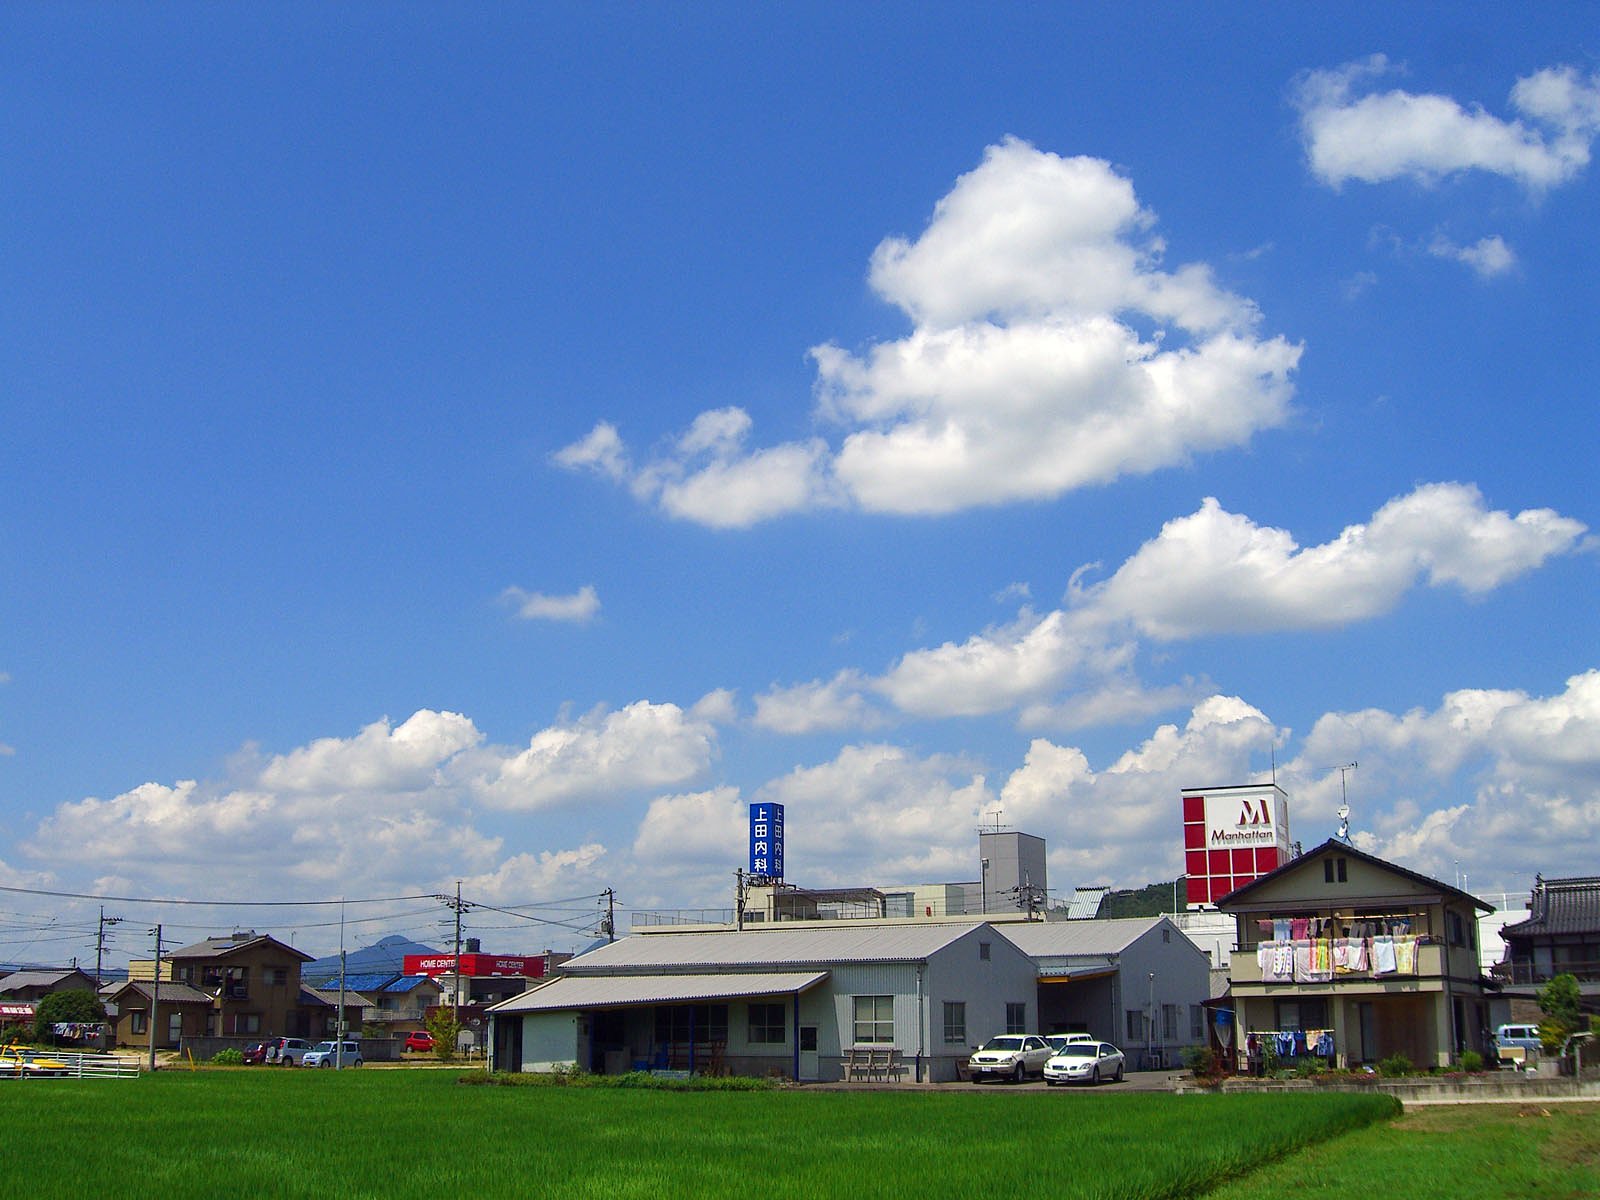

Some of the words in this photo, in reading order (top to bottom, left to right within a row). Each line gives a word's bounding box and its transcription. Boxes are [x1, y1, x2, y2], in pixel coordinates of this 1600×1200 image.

[1239, 799, 1271, 825] M
[754, 807, 768, 872] 上田内科
[774, 808, 782, 872] 上田内科
[1211, 829, 1273, 841] Manhattan
[420, 959, 436, 968] HOME
[436, 959, 456, 968] CENTE
[495, 960, 508, 968] HOME
[508, 960, 524, 969] CENTER
